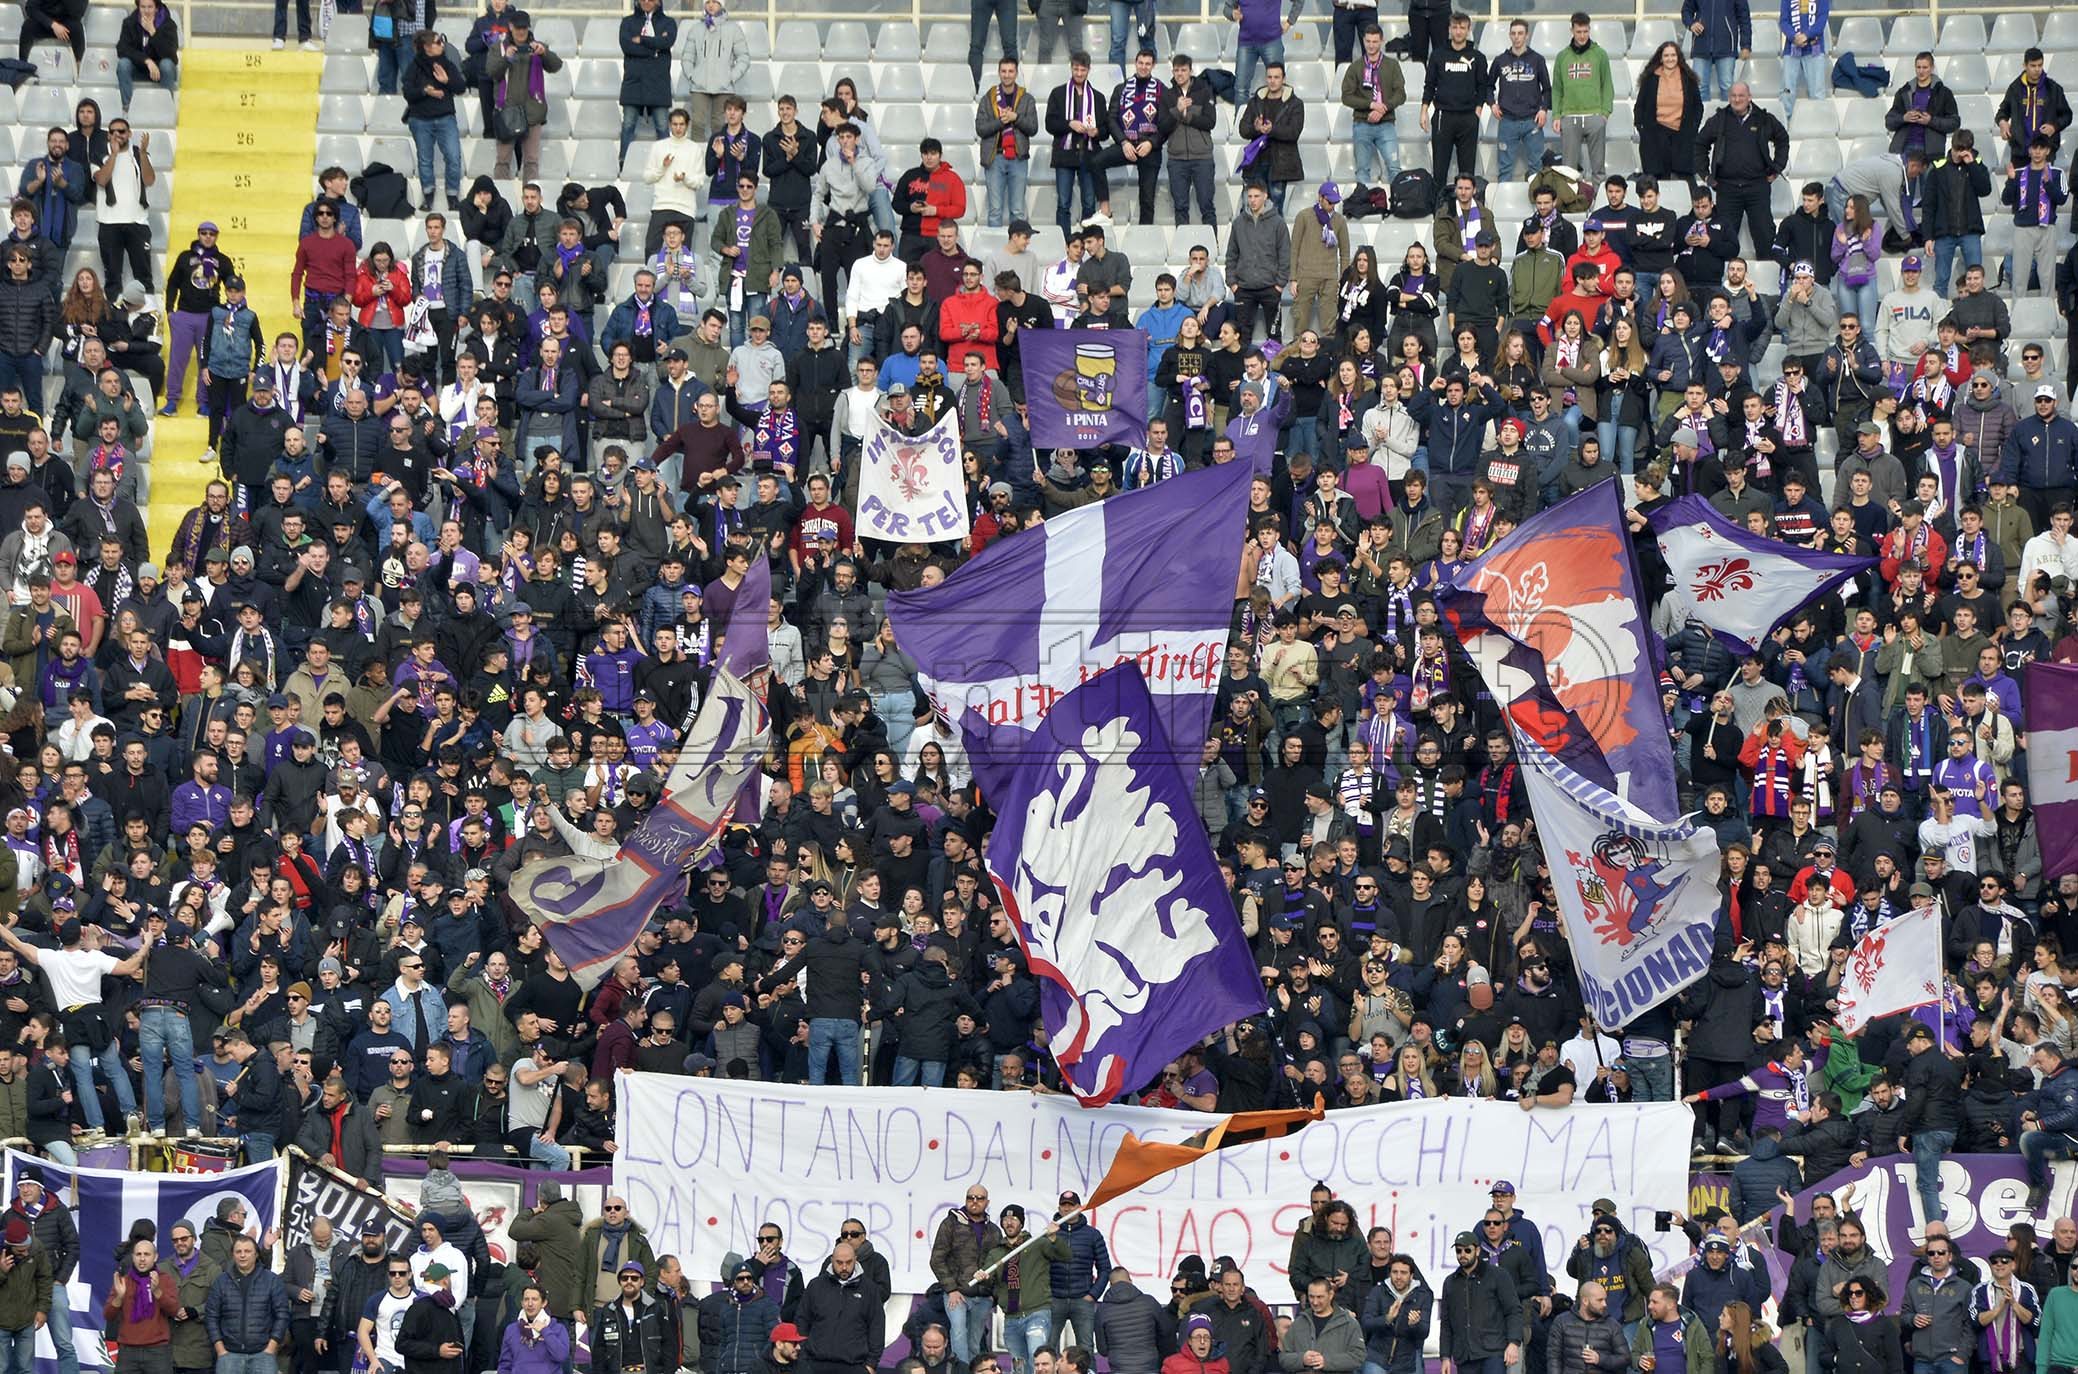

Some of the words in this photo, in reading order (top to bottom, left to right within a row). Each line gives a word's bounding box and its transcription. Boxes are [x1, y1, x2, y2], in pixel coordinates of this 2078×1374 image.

[245, 54, 262, 67] 28
[240, 93, 257, 107] 27
[237, 131, 255, 146] 26
[234, 174, 252, 188] 25
[231, 215, 248, 230] 24
[1892, 305, 1930, 322] FILA
[1073, 413, 1108, 427] PINTA
[861, 494, 910, 537] PER
[917, 490, 963, 536] TE!
[487, 693, 510, 704] adidas
[1948, 788, 1975, 798] OYOTA
[623, 1078, 923, 1184] LONTANO
[1520, 1105, 1643, 1197] MAI
[1109, 1204, 1252, 1279] CIAO
